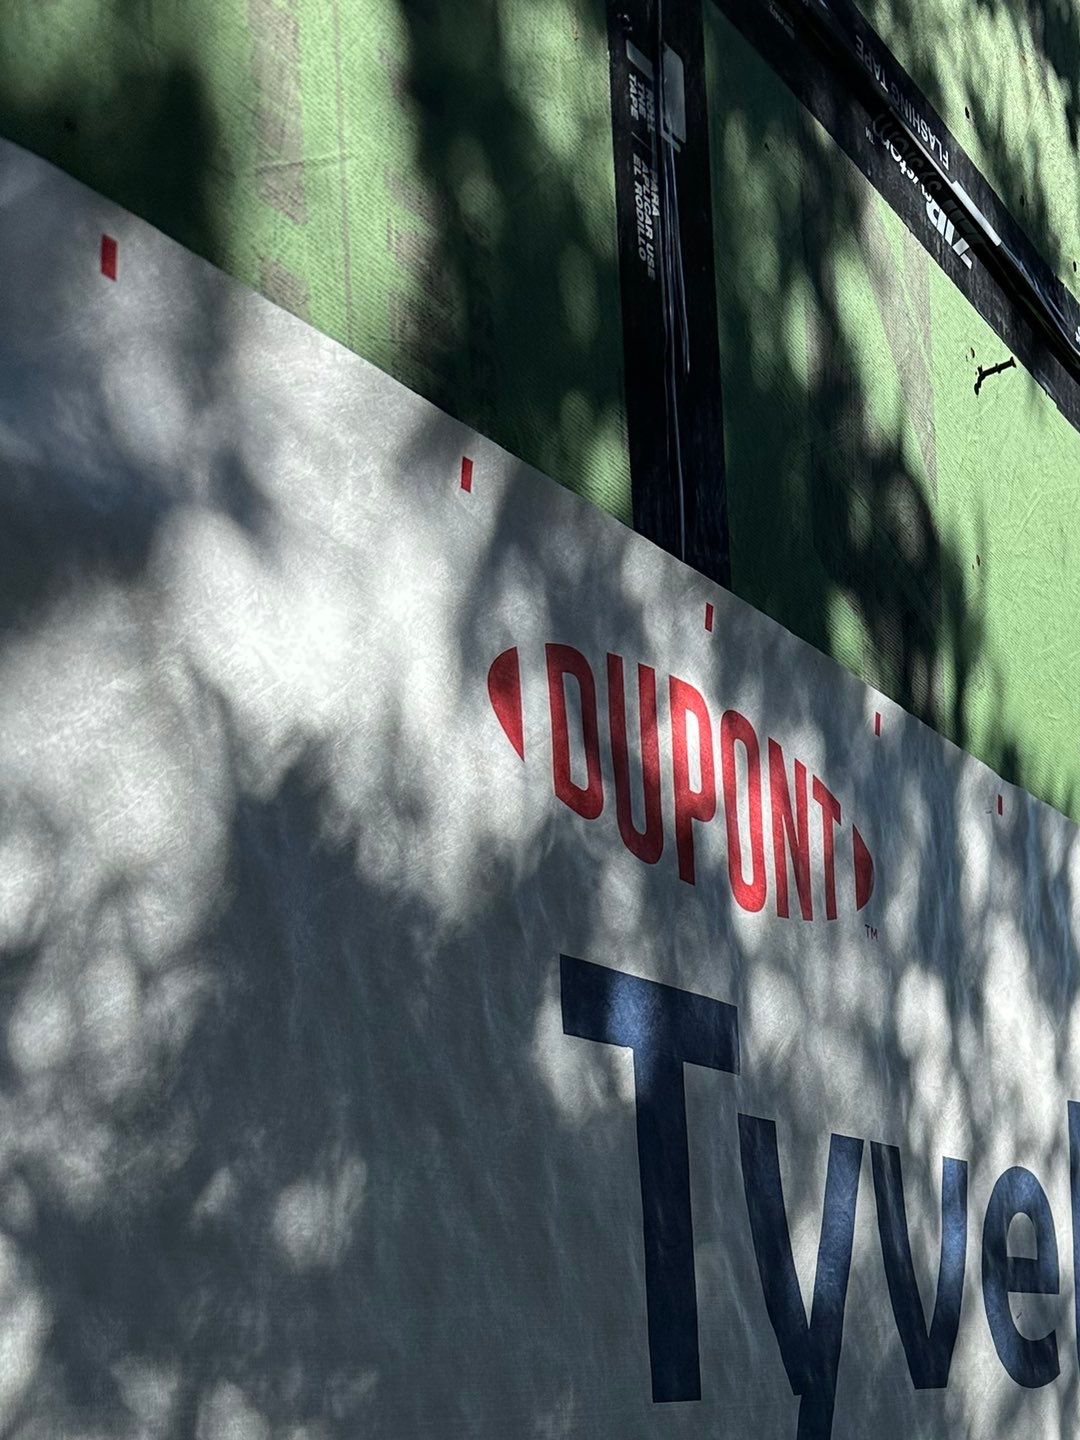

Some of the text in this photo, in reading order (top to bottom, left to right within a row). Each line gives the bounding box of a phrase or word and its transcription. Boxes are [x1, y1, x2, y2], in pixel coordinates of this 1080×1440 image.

[627, 72, 640, 122] TAPE
[857, 37, 951, 170] FLASHING TAPE
[633, 152, 648, 263] EL RODILLO
[641, 160, 657, 281] APLICAR USE
[545, 643, 841, 921] DUPONT
